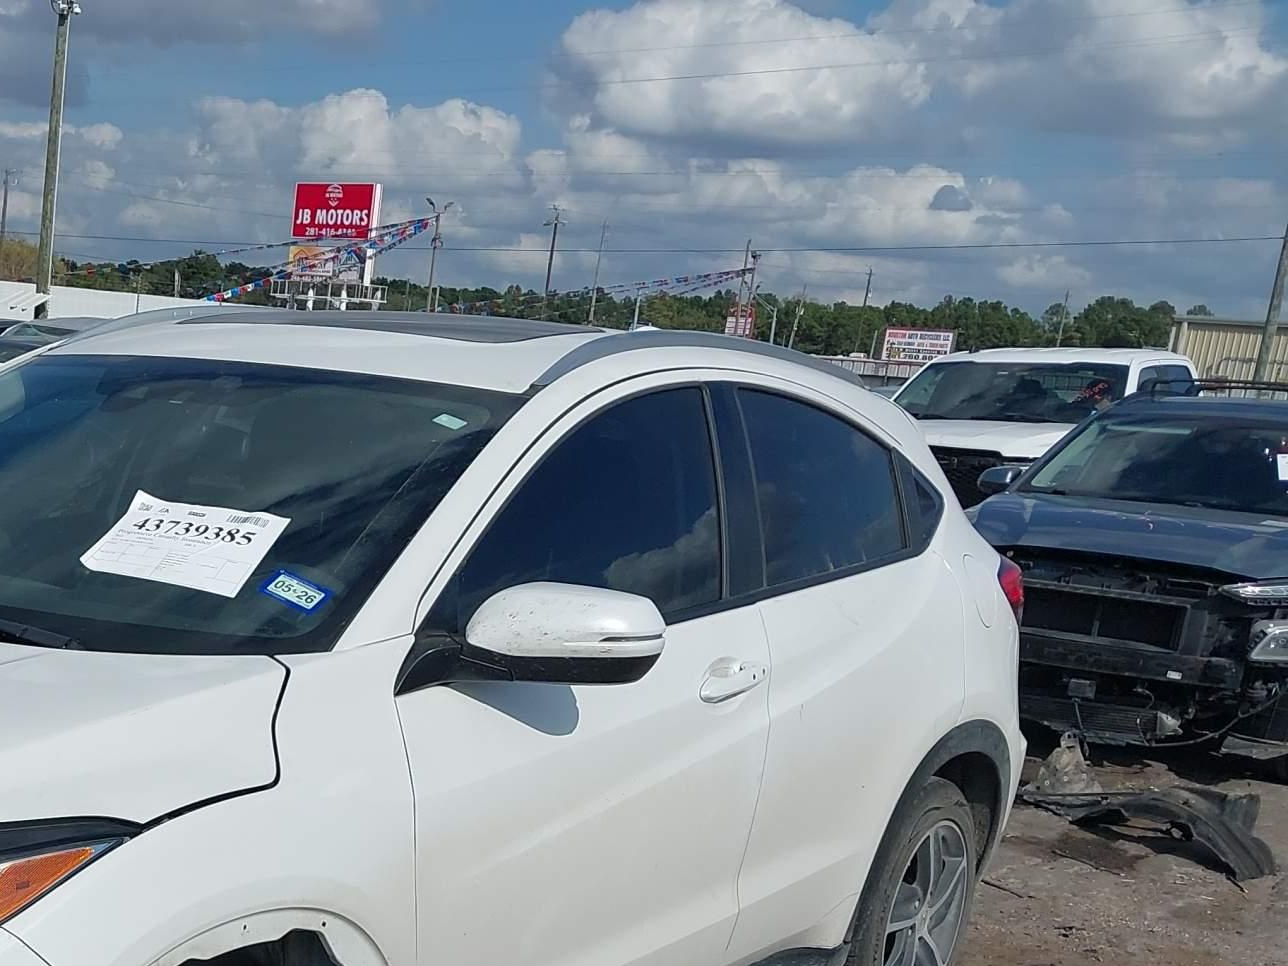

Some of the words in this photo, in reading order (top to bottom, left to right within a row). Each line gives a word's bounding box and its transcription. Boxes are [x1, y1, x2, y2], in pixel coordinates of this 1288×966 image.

[296, 209, 311, 225] JB
[315, 209, 369, 226] MOTORS
[133, 517, 257, 546] 43739385
